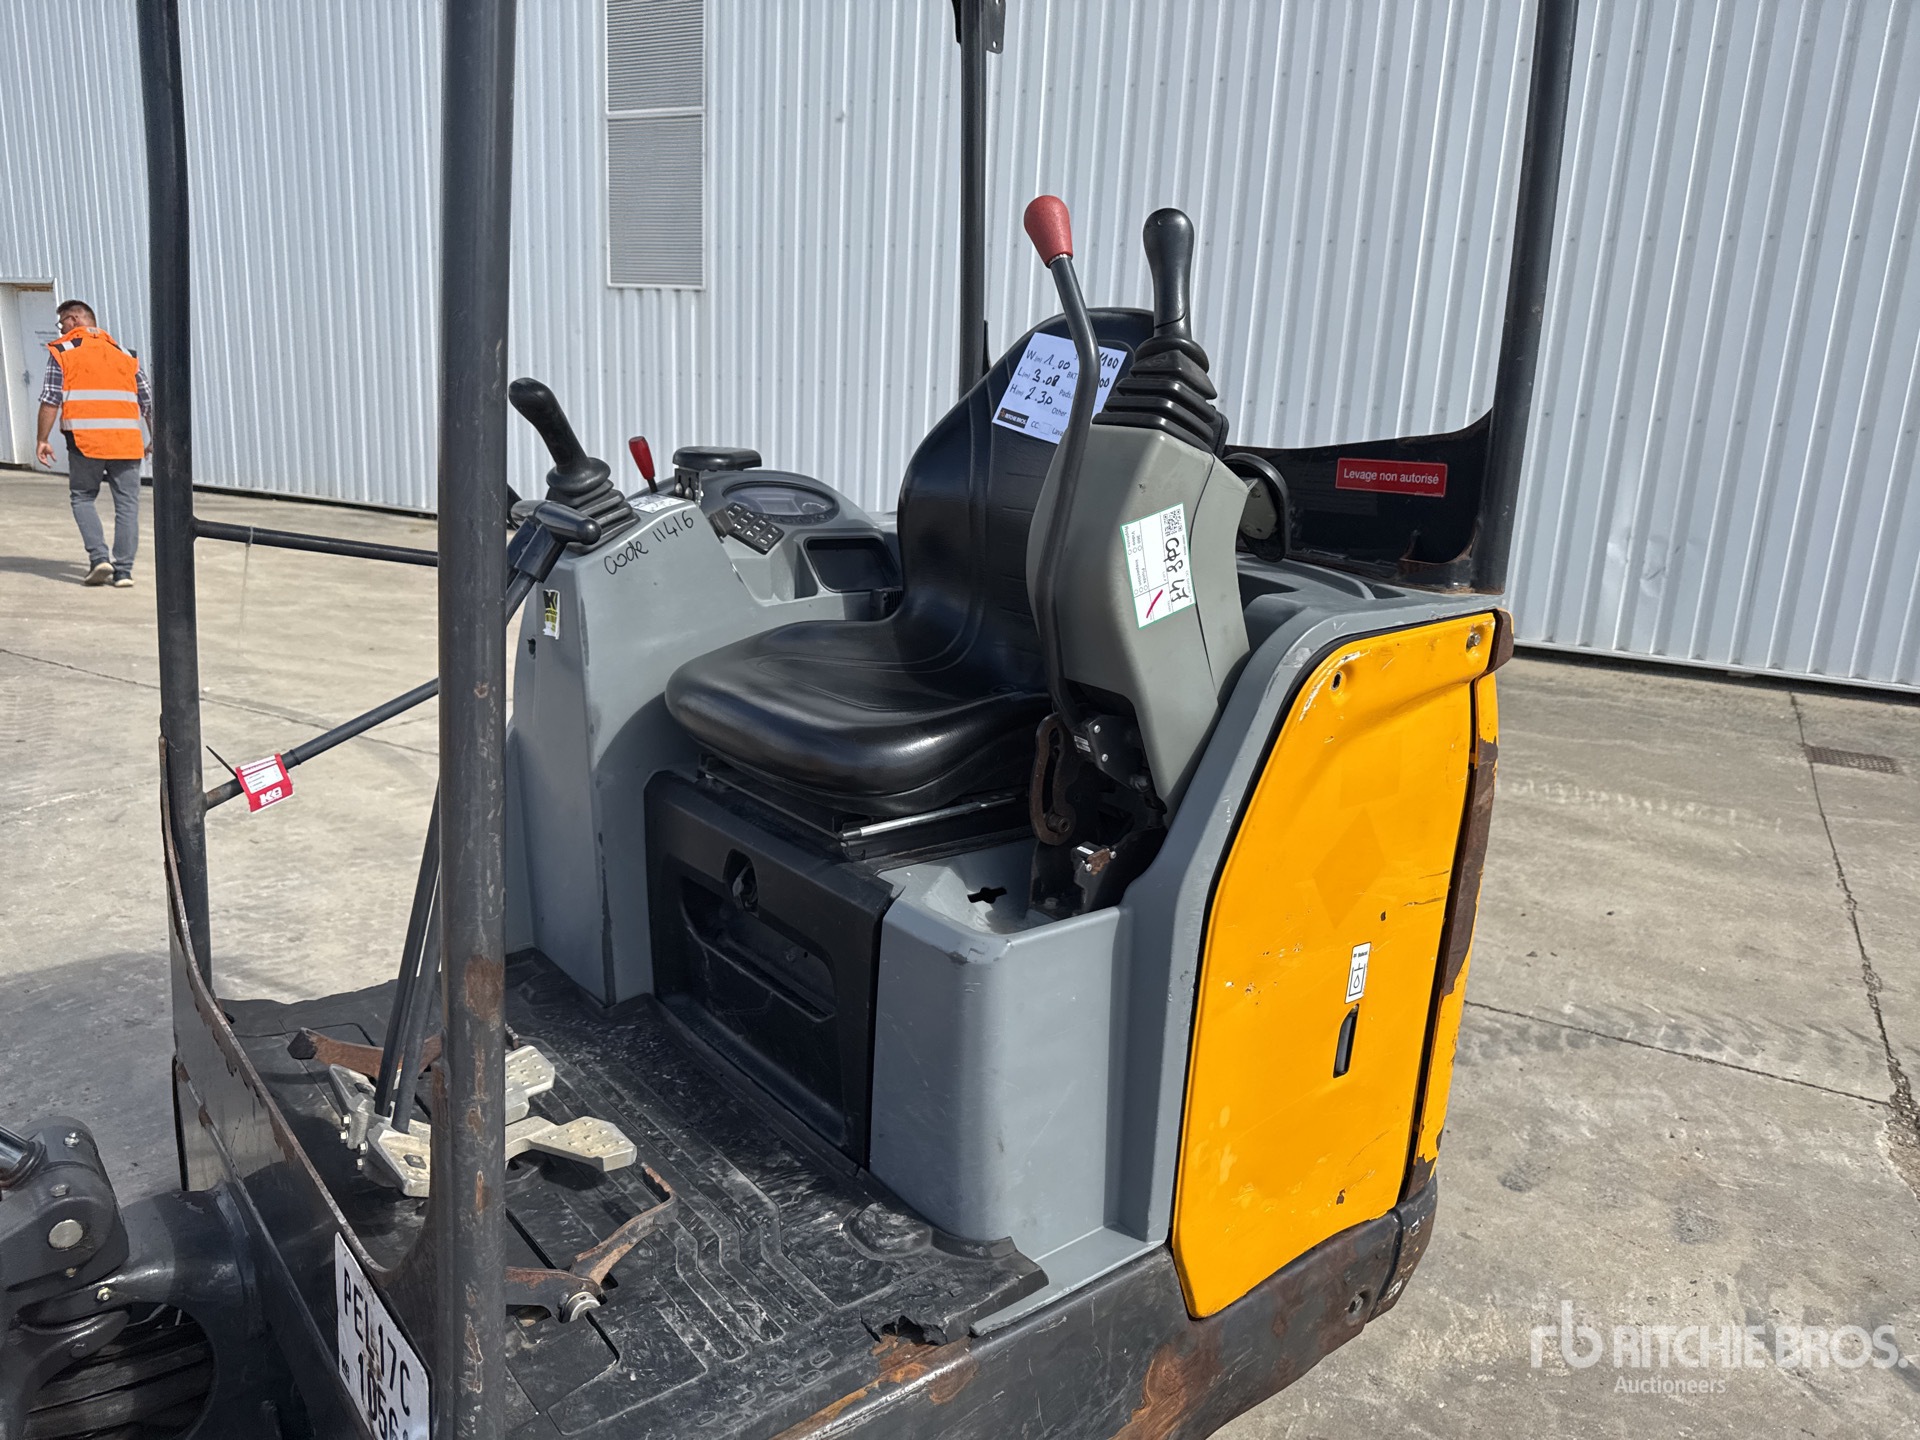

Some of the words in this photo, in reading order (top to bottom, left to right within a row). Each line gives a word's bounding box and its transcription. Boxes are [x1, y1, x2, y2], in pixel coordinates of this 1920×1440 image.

[1343, 468, 1377, 483] Levage
[1380, 472, 1397, 481] non
[1400, 473, 1439, 485] autorisé
